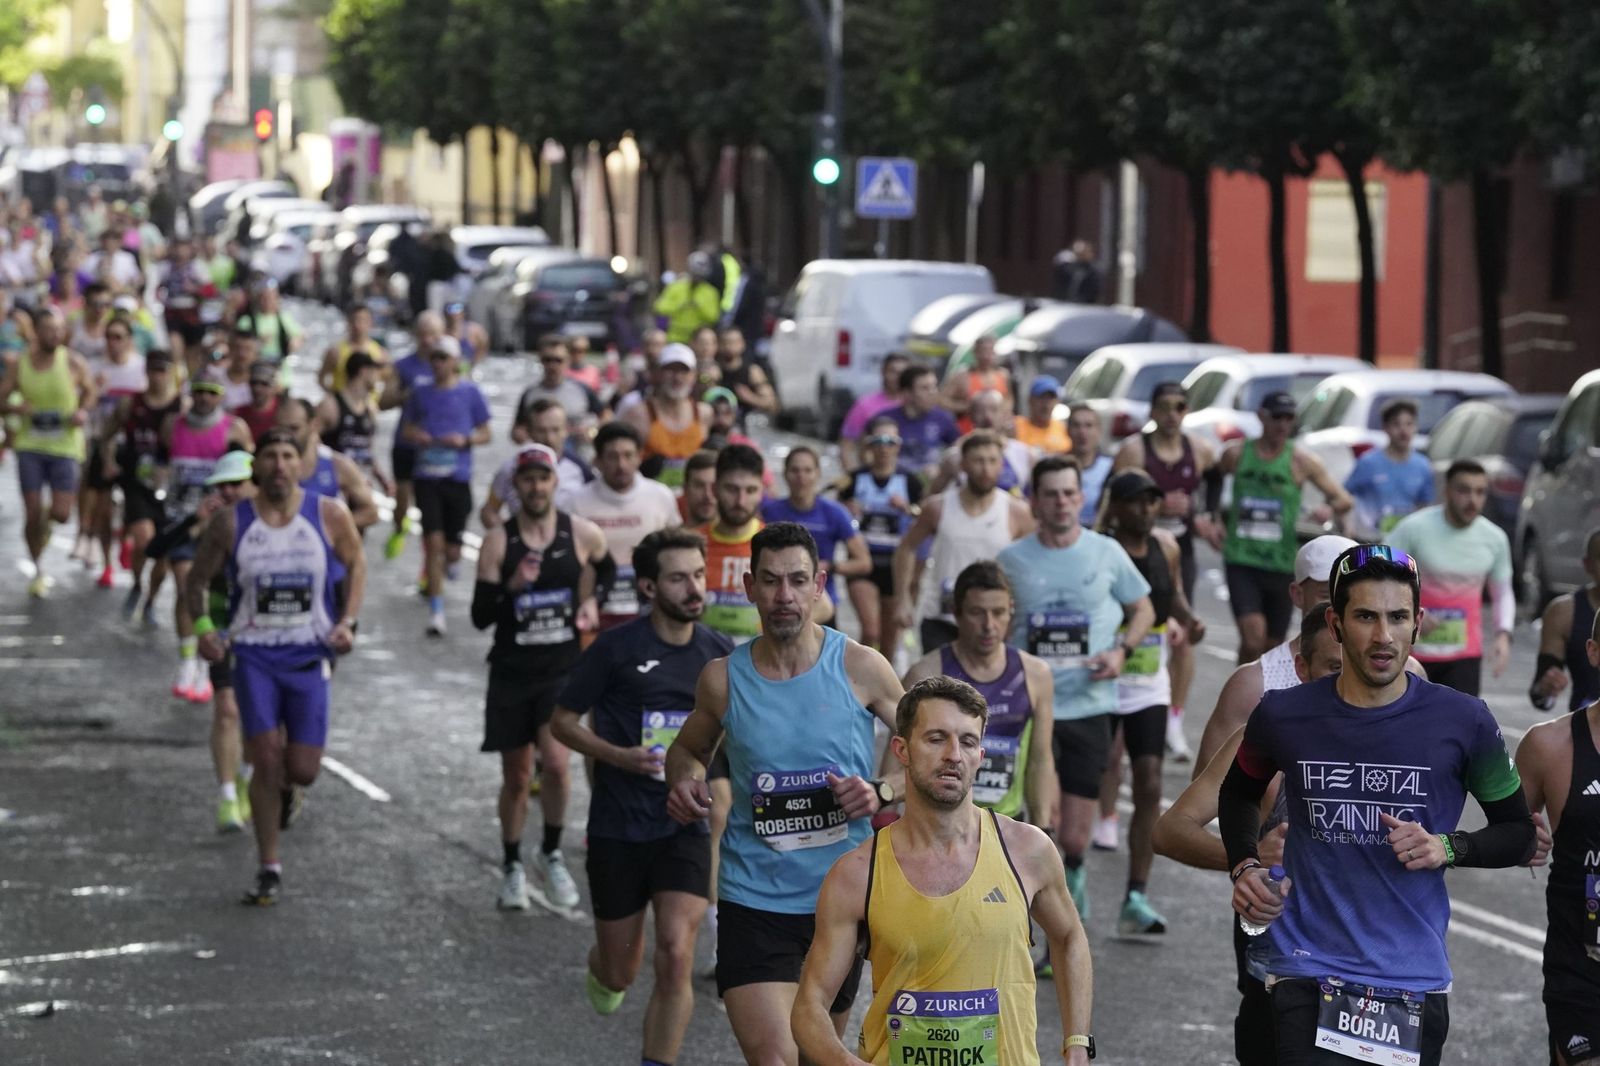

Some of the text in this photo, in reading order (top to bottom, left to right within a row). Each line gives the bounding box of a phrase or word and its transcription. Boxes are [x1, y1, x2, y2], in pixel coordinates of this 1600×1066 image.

[781, 771, 831, 787] ZURICH
[1297, 760, 1431, 796] THE TOTAL
[785, 798, 812, 811] 4521
[755, 815, 823, 835] ROBERTO
[1311, 828, 1331, 842] DOS
[925, 998, 985, 1012] ZURICH
[1357, 997, 1386, 1015] 4381
[926, 1028, 960, 1042] 2620
[1338, 1010, 1400, 1045] BORJA
[902, 1045, 984, 1066] PATRICK
